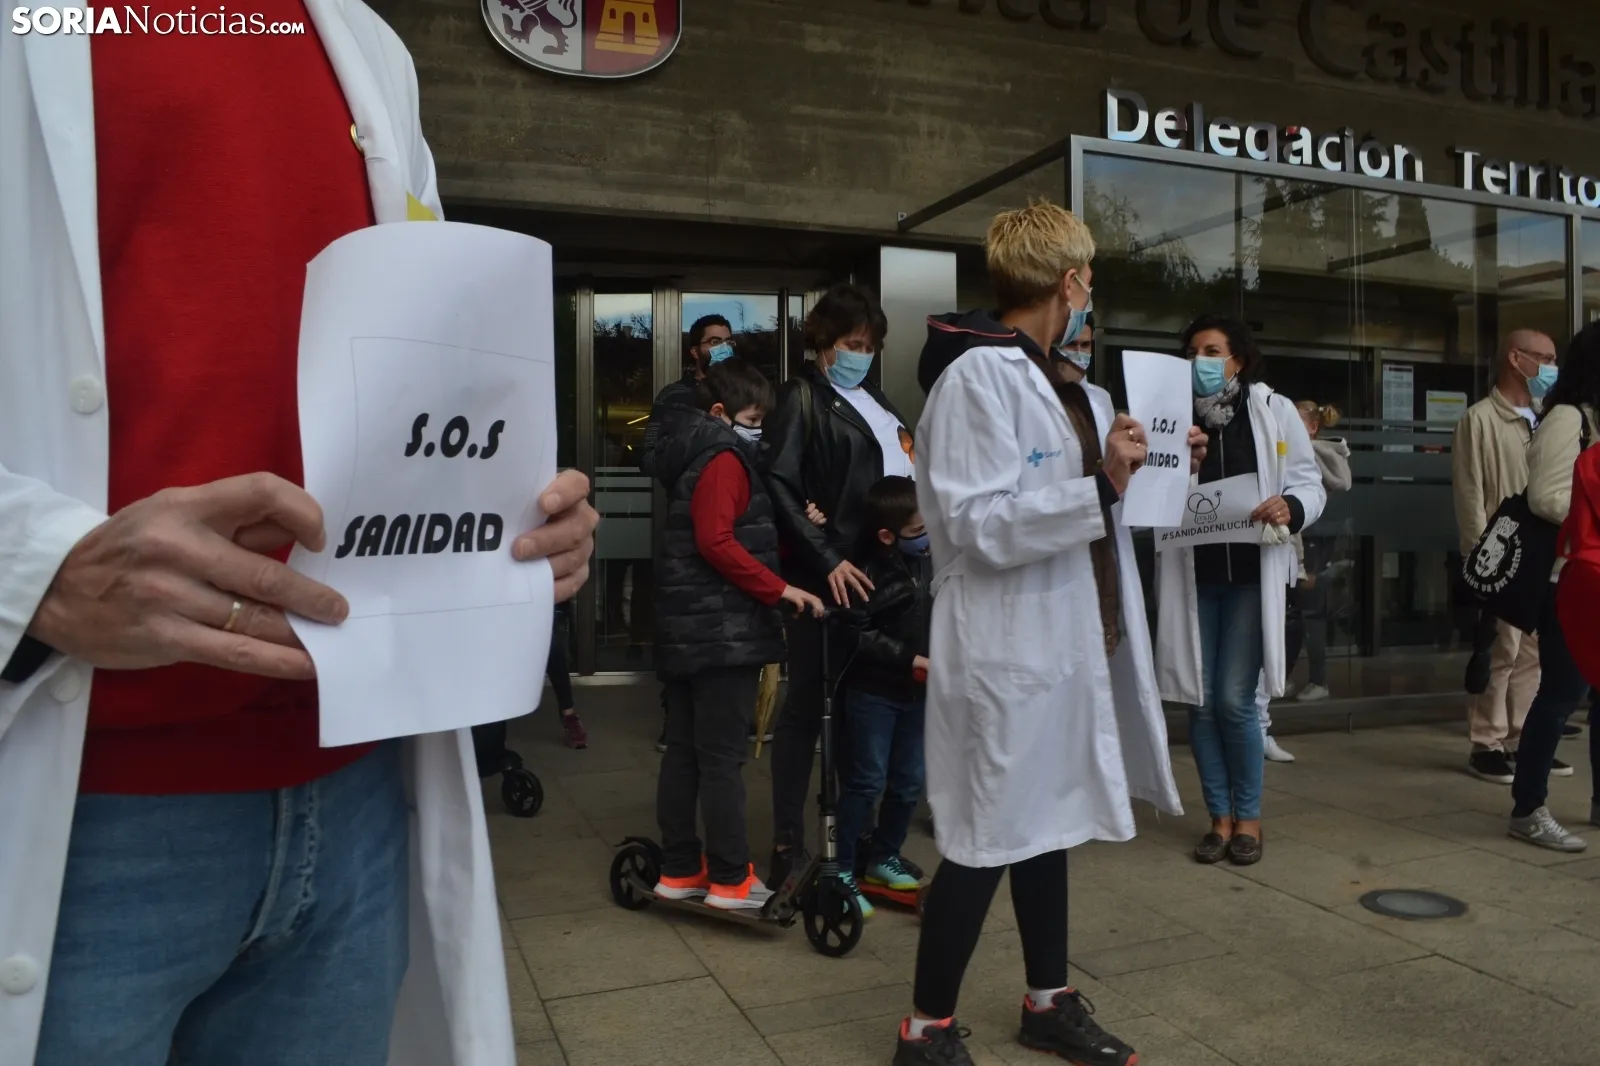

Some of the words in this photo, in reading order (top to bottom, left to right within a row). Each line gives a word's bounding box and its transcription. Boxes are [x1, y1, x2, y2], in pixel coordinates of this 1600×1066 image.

[404, 412, 506, 460] S.O.S
[1151, 416, 1177, 435] S.O.S
[1144, 451, 1180, 469] NIDAD
[334, 511, 504, 559] SANIDAD
[1161, 518, 1255, 541] #SANIDADENLUCHA
